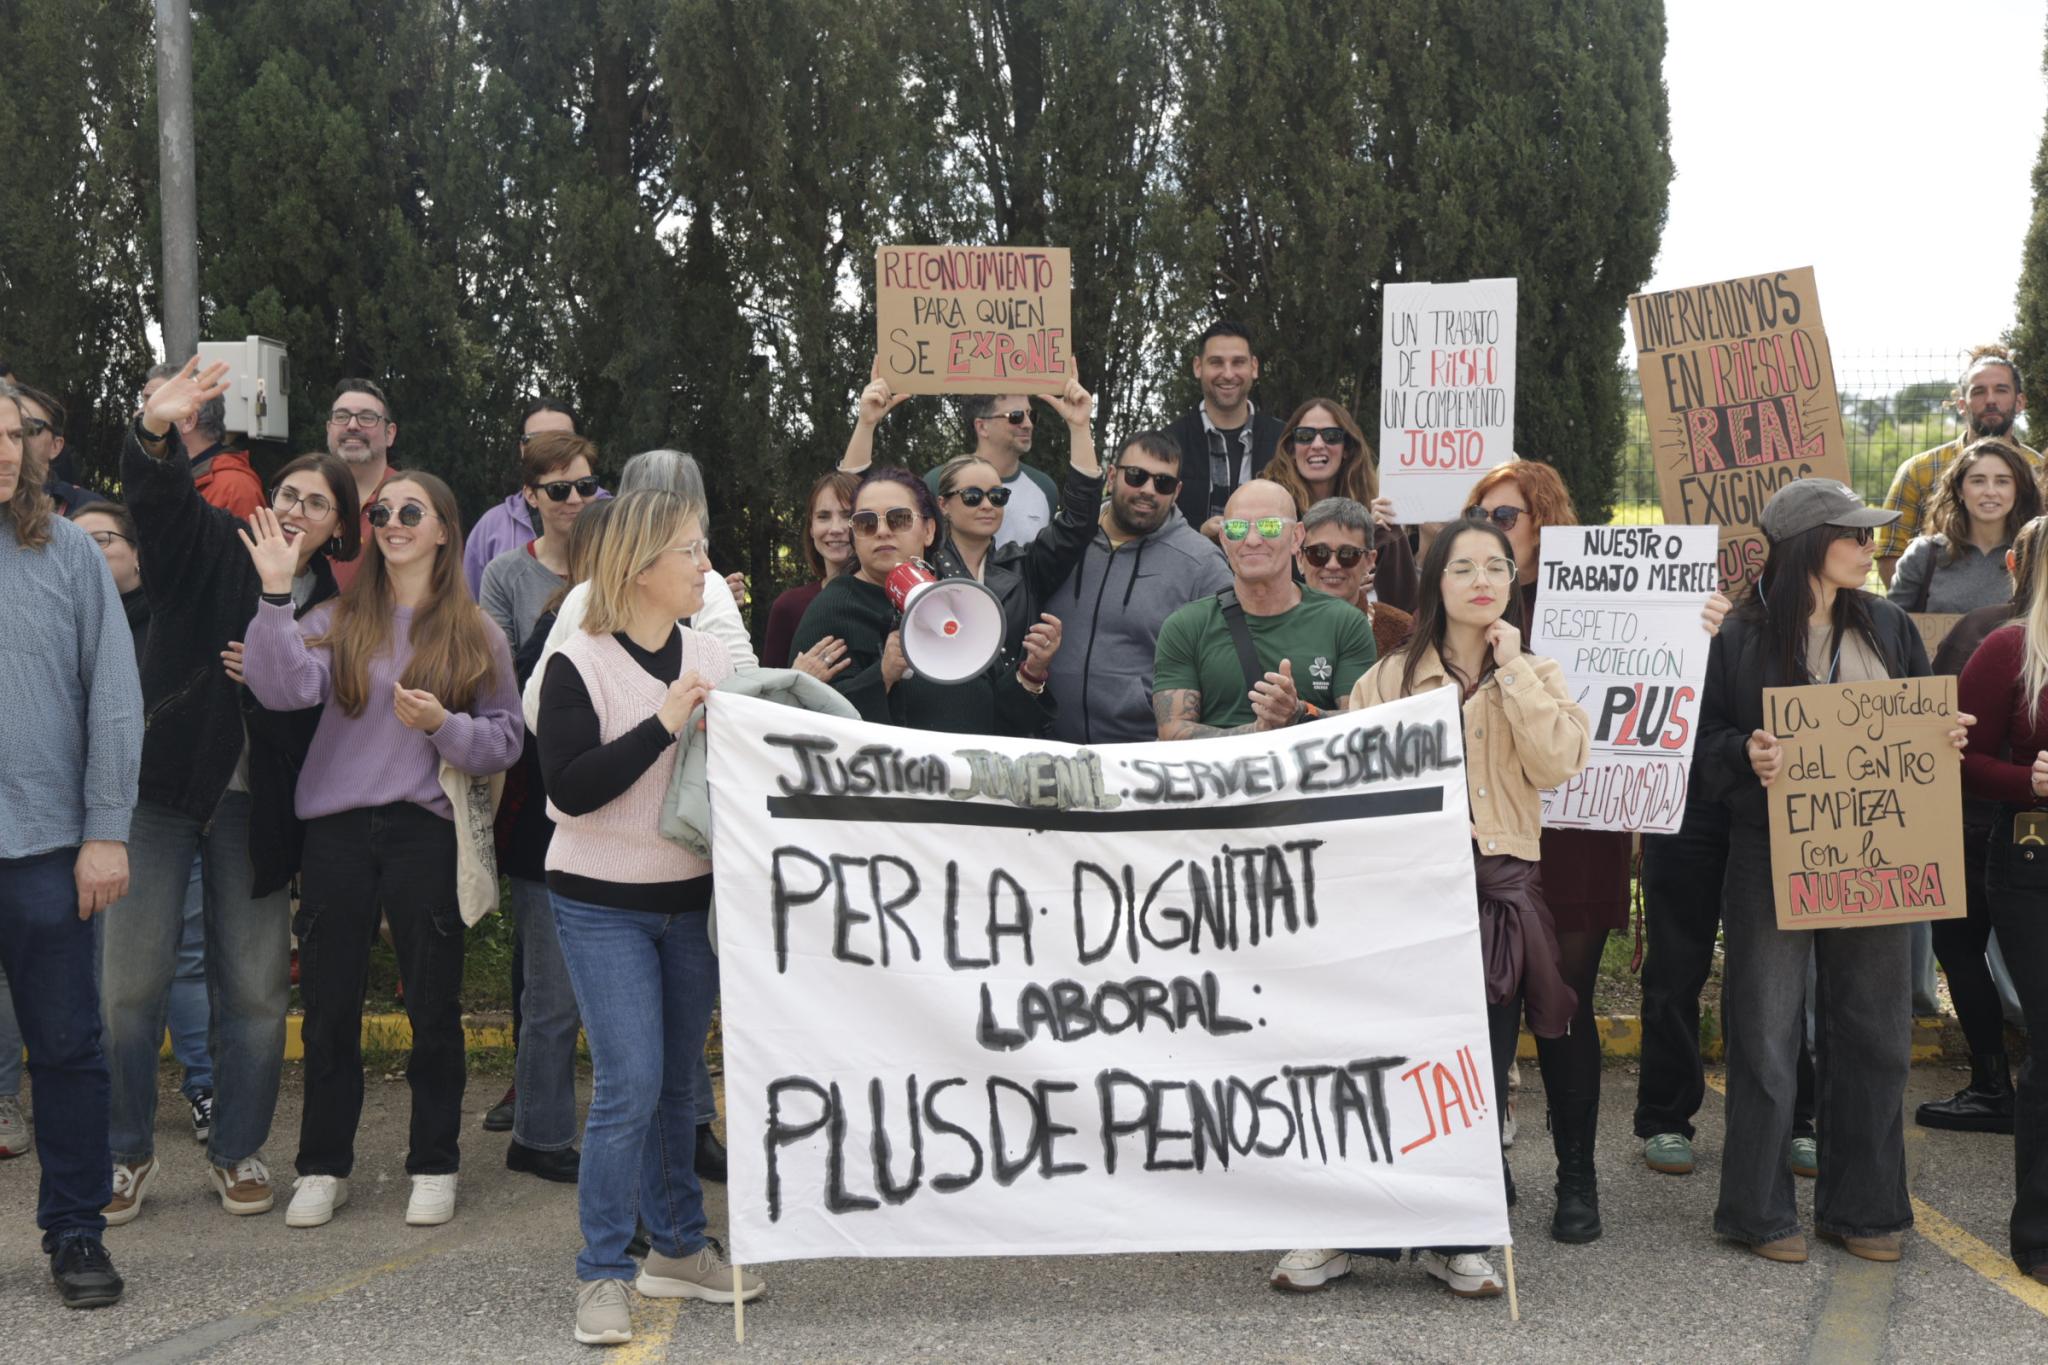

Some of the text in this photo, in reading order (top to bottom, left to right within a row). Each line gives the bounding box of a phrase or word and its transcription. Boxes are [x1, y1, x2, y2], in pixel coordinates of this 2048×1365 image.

[913, 296, 966, 329] PARA
[1391, 310, 1499, 346] UN TRABAJO
[1631, 273, 1801, 353] INTERVENIMOS
[889, 328, 1065, 377] SE EXPONE
[1399, 350, 1421, 387] DE
[1661, 352, 1705, 413] EN
[1384, 388, 1505, 429] UN COMPLEMENTO
[1400, 429, 1484, 469] JUSTO
[1682, 395, 1825, 475] REAL
[1583, 528, 1683, 559] NUESTRO
[1717, 538, 1766, 592] US
[1544, 561, 1717, 592] TRABAJO MERECE
[1594, 682, 1695, 750] PLUS
[1290, 719, 1463, 795] ESSENCIAL
[1858, 830, 1893, 868] la
[772, 845, 922, 974] PER
[1789, 863, 1946, 916] NUESTRA
[763, 1072, 984, 1224] PLUS
[985, 1074, 1089, 1188] DE
